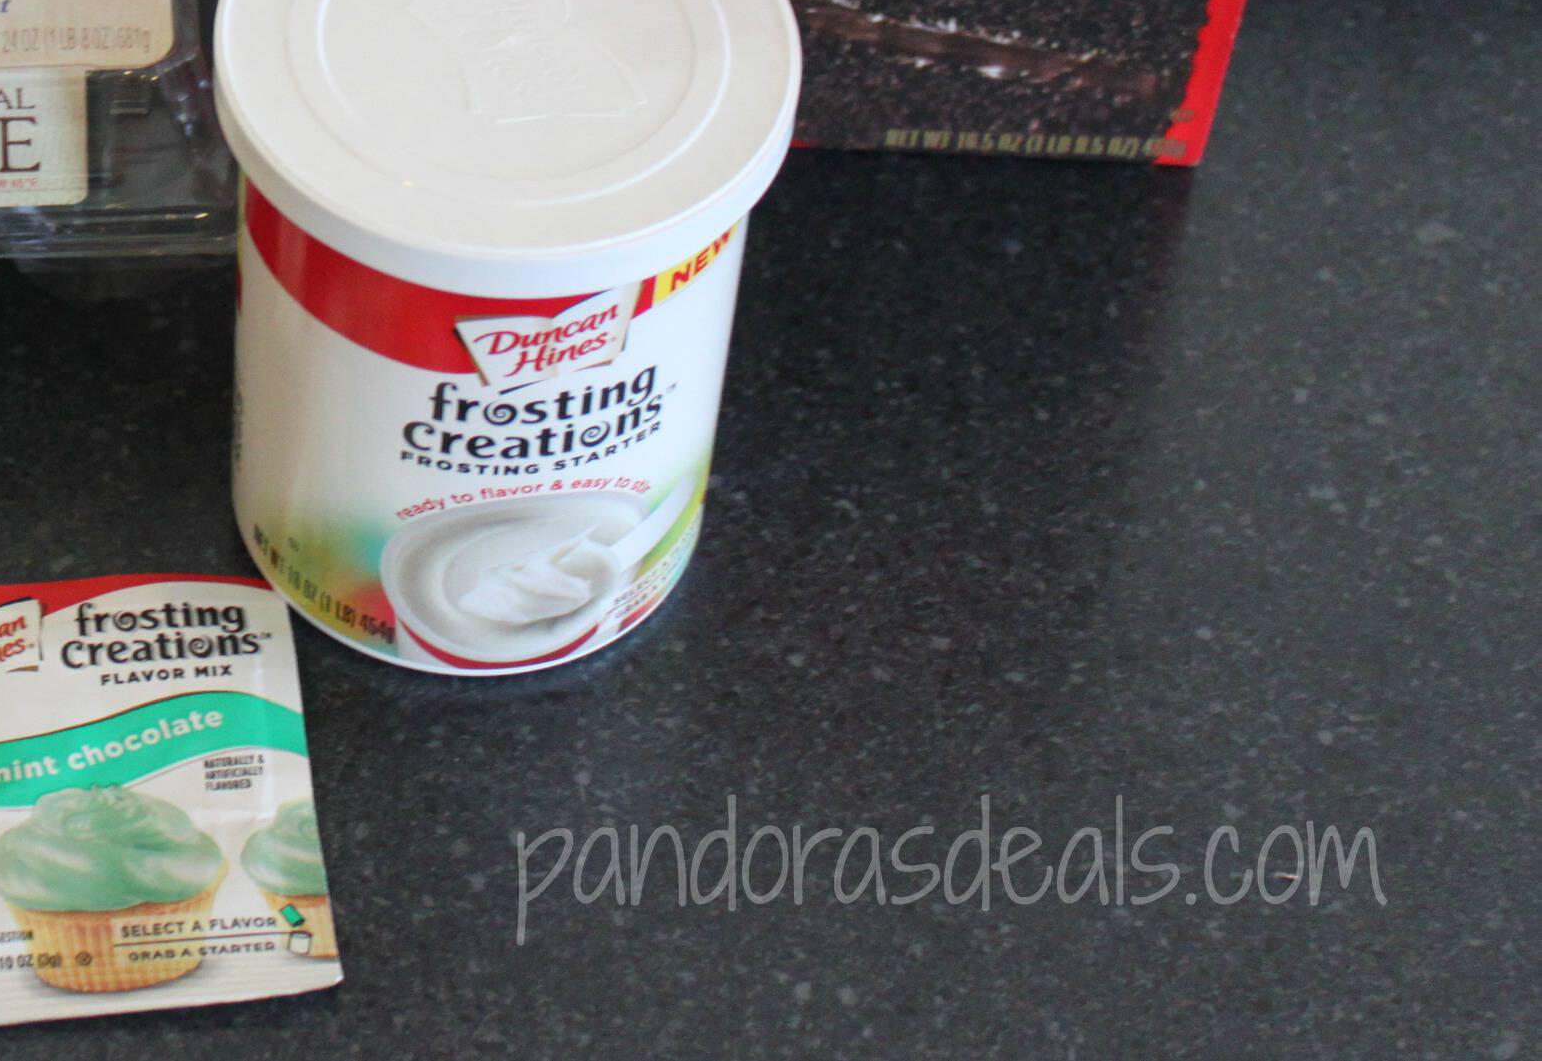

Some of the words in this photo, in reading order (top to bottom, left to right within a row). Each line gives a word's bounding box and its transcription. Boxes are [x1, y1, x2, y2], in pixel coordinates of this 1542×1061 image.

[473, 302, 620, 356] Duncan
[506, 333, 608, 378] Hines
[428, 363, 658, 427] frosting
[399, 450, 541, 477] FROSTING
[552, 421, 662, 472] STARTER
[395, 498, 447, 522] ready
[449, 491, 474, 506] to
[479, 480, 544, 501] flavor
[549, 480, 563, 492] &
[570, 475, 613, 492] easy
[614, 475, 632, 490] to
[74, 601, 247, 638] frosting
[101, 667, 185, 687] FLAVOR
[194, 664, 233, 678] MIX
[66, 708, 224, 772] chocolate
[120, 920, 187, 939] SELECT
[191, 919, 205, 934] A
[208, 915, 278, 933] FLAVOR
[17, 952, 35, 970] OZ
[127, 947, 178, 963] GRAB
[180, 947, 193, 960] A
[197, 941, 277, 957] STARTER
